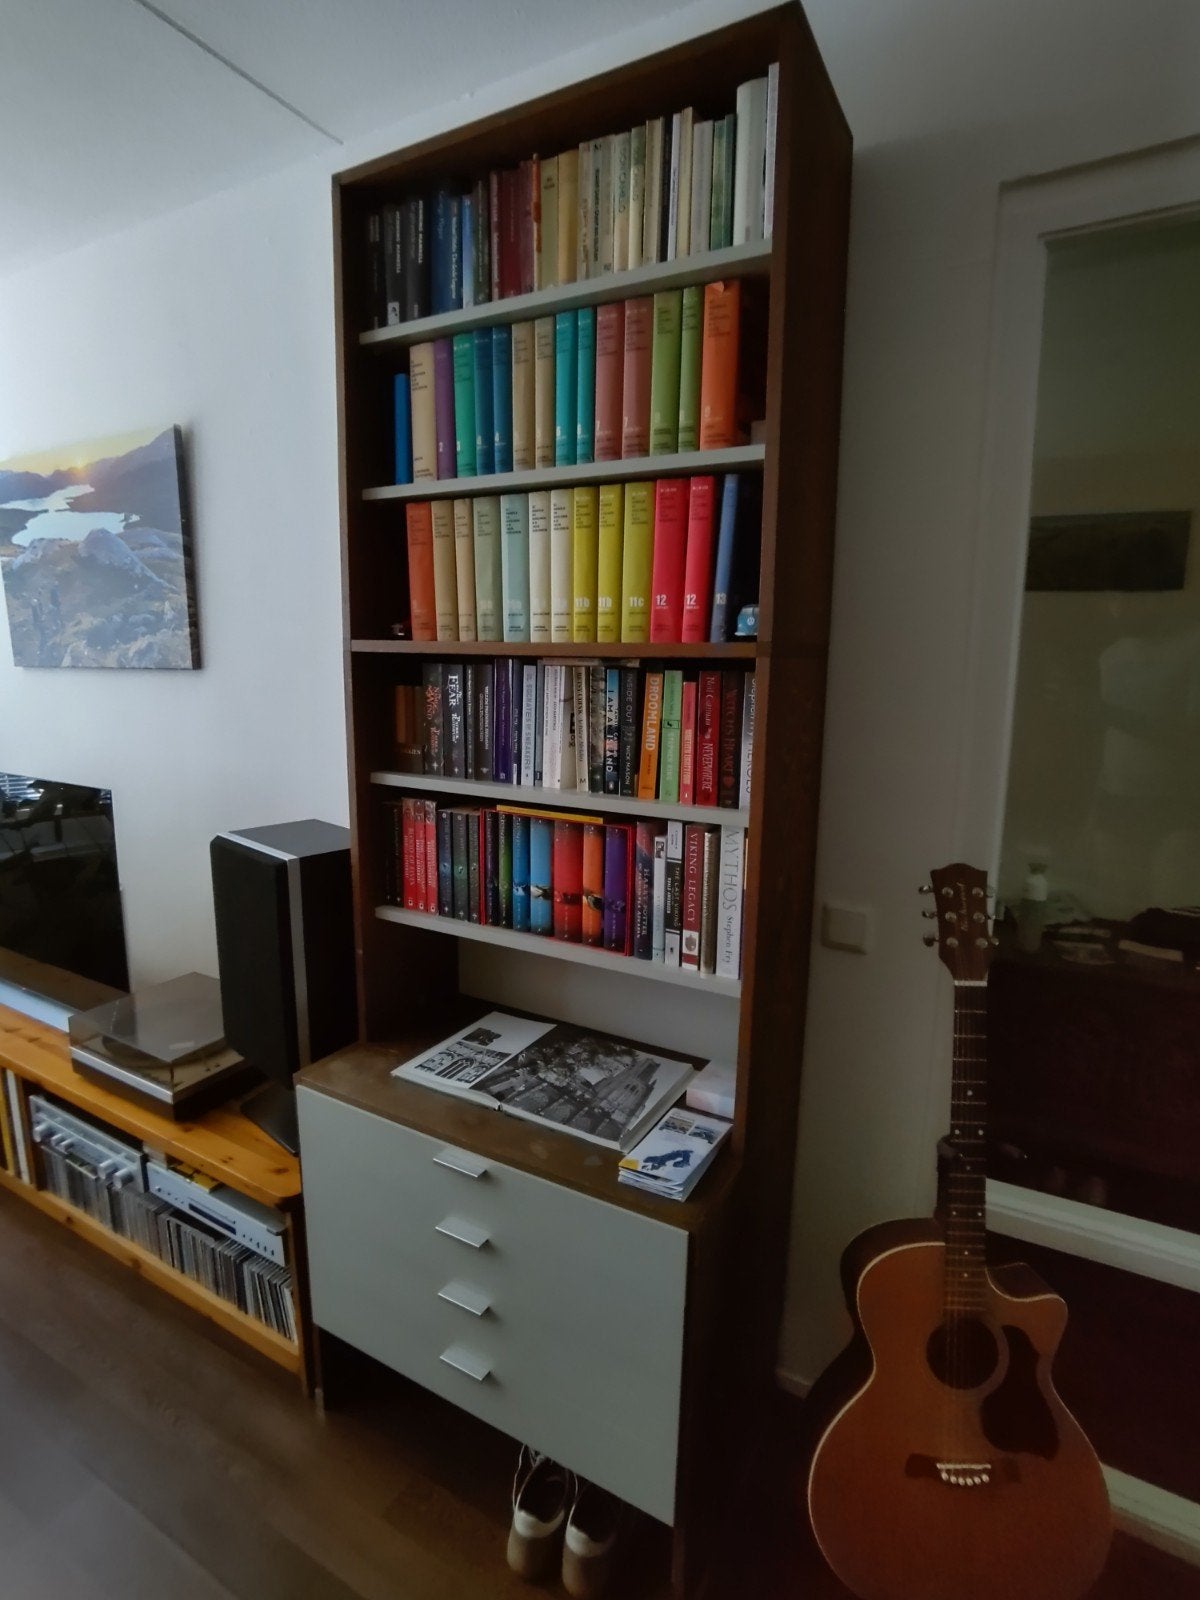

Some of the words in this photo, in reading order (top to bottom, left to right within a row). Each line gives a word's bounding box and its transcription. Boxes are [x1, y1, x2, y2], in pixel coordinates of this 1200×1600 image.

[630, 597, 644, 608] 11c
[656, 594, 668, 606] 12
[686, 594, 697, 606] 12
[716, 593, 726, 605] 13
[448, 674, 460, 707] FEAR
[576, 672, 584, 694] BETSY
[706, 676, 715, 692] Neil
[608, 698, 614, 713] AM
[645, 677, 660, 750] DROOMLAND
[705, 694, 714, 726] Gaiman
[524, 732, 532, 770] SNEAKERS
[722, 738, 736, 776] HEART
[624, 762, 632, 785] MASON
[702, 742, 714, 793] NEVERWHERE
[689, 833, 698, 874] VIKING
[642, 868, 650, 900] HARRY
[722, 828, 740, 912] MYTHOS
[687, 879, 696, 924] LEGACY
[724, 915, 734, 948] Stephen
